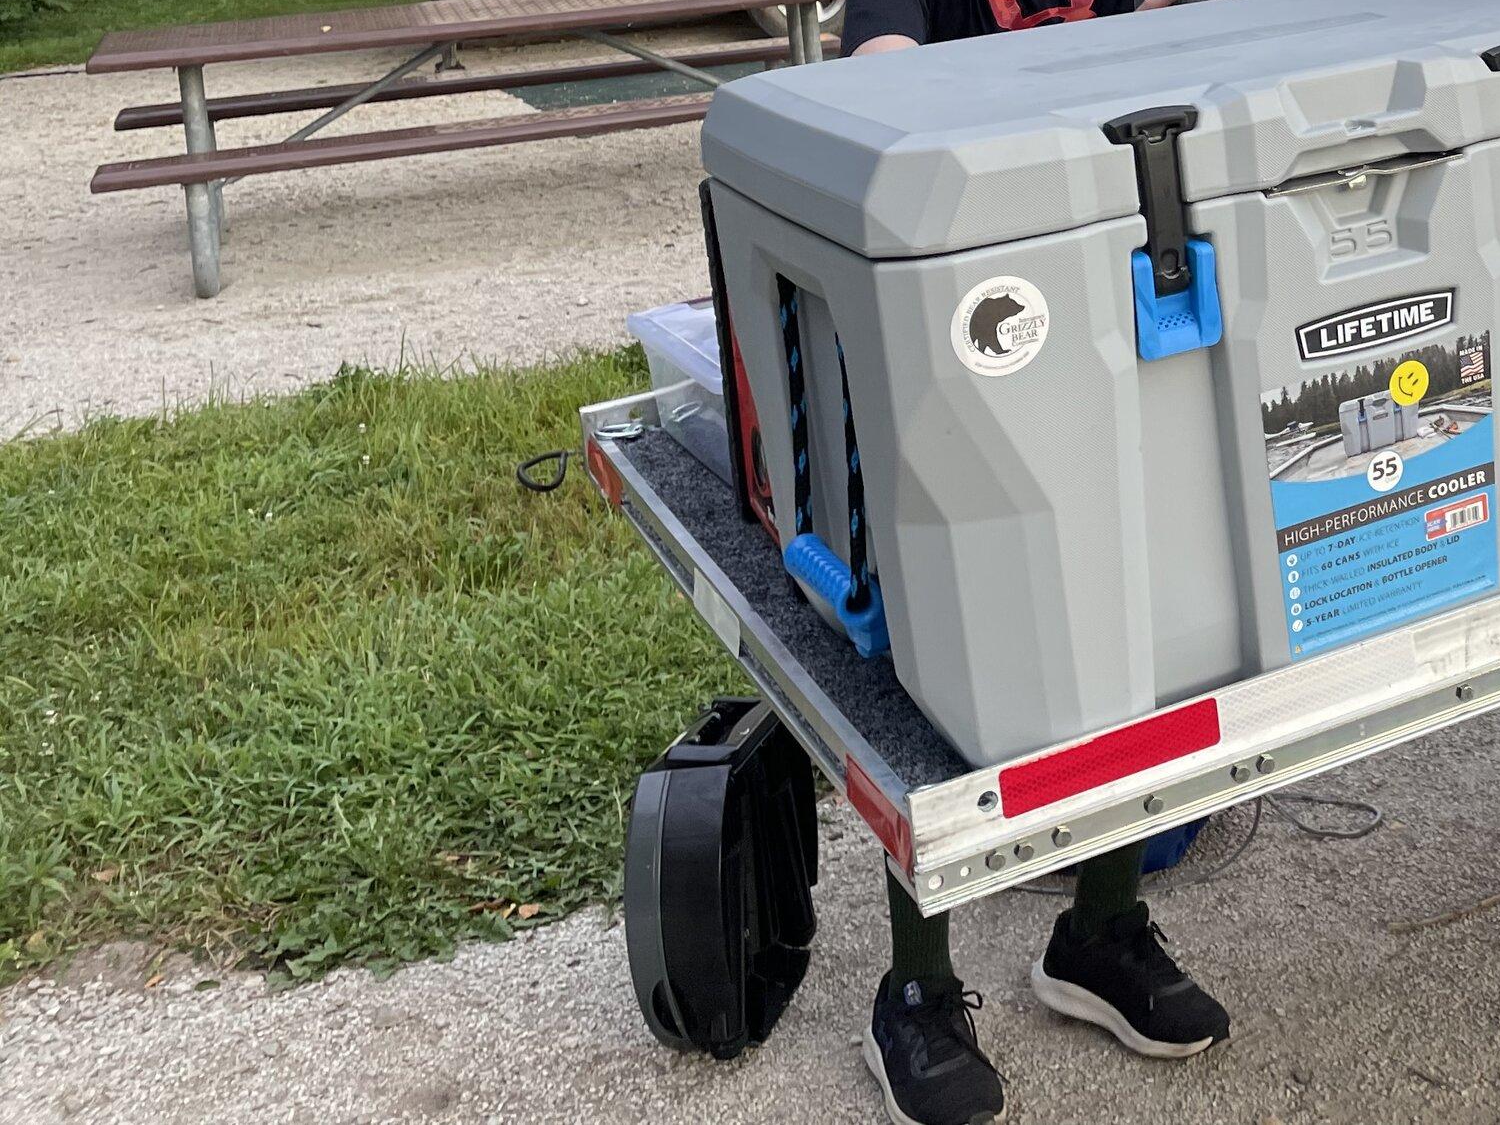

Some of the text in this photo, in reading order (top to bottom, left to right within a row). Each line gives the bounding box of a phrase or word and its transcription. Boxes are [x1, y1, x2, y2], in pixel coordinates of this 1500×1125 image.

[967, 296, 981, 315] BEAR
[981, 285, 1020, 298] RESISTANT
[999, 319, 1046, 335] GRIZZLY
[1012, 329, 1038, 343] BEAR
[1319, 301, 1435, 348] LIFETIME
[1460, 347, 1476, 356] MADE
[1372, 457, 1398, 481] 55
[1284, 471, 1486, 546] HIGH-PERFORMANCE COOLER
[1300, 550, 1312, 562] UP
[1315, 546, 1326, 556] TO
[1328, 535, 1356, 552] 7-DAY
[1321, 561, 1333, 571] 60
[1335, 551, 1361, 566] CANS
[1363, 543, 1385, 557] WITH
[1386, 538, 1399, 549] ICE
[1367, 551, 1414, 572] INSULATED
[1415, 542, 1438, 556] BODY
[1446, 535, 1460, 545] LID
[1304, 596, 1328, 610] LOCK
[1329, 580, 1373, 602] LOCATION
[1382, 567, 1414, 584] BOTTLE
[1415, 555, 1448, 572] OPENER
[1306, 608, 1340, 627] 5-YEAR
[1378, 580, 1424, 603] WARRANTY
